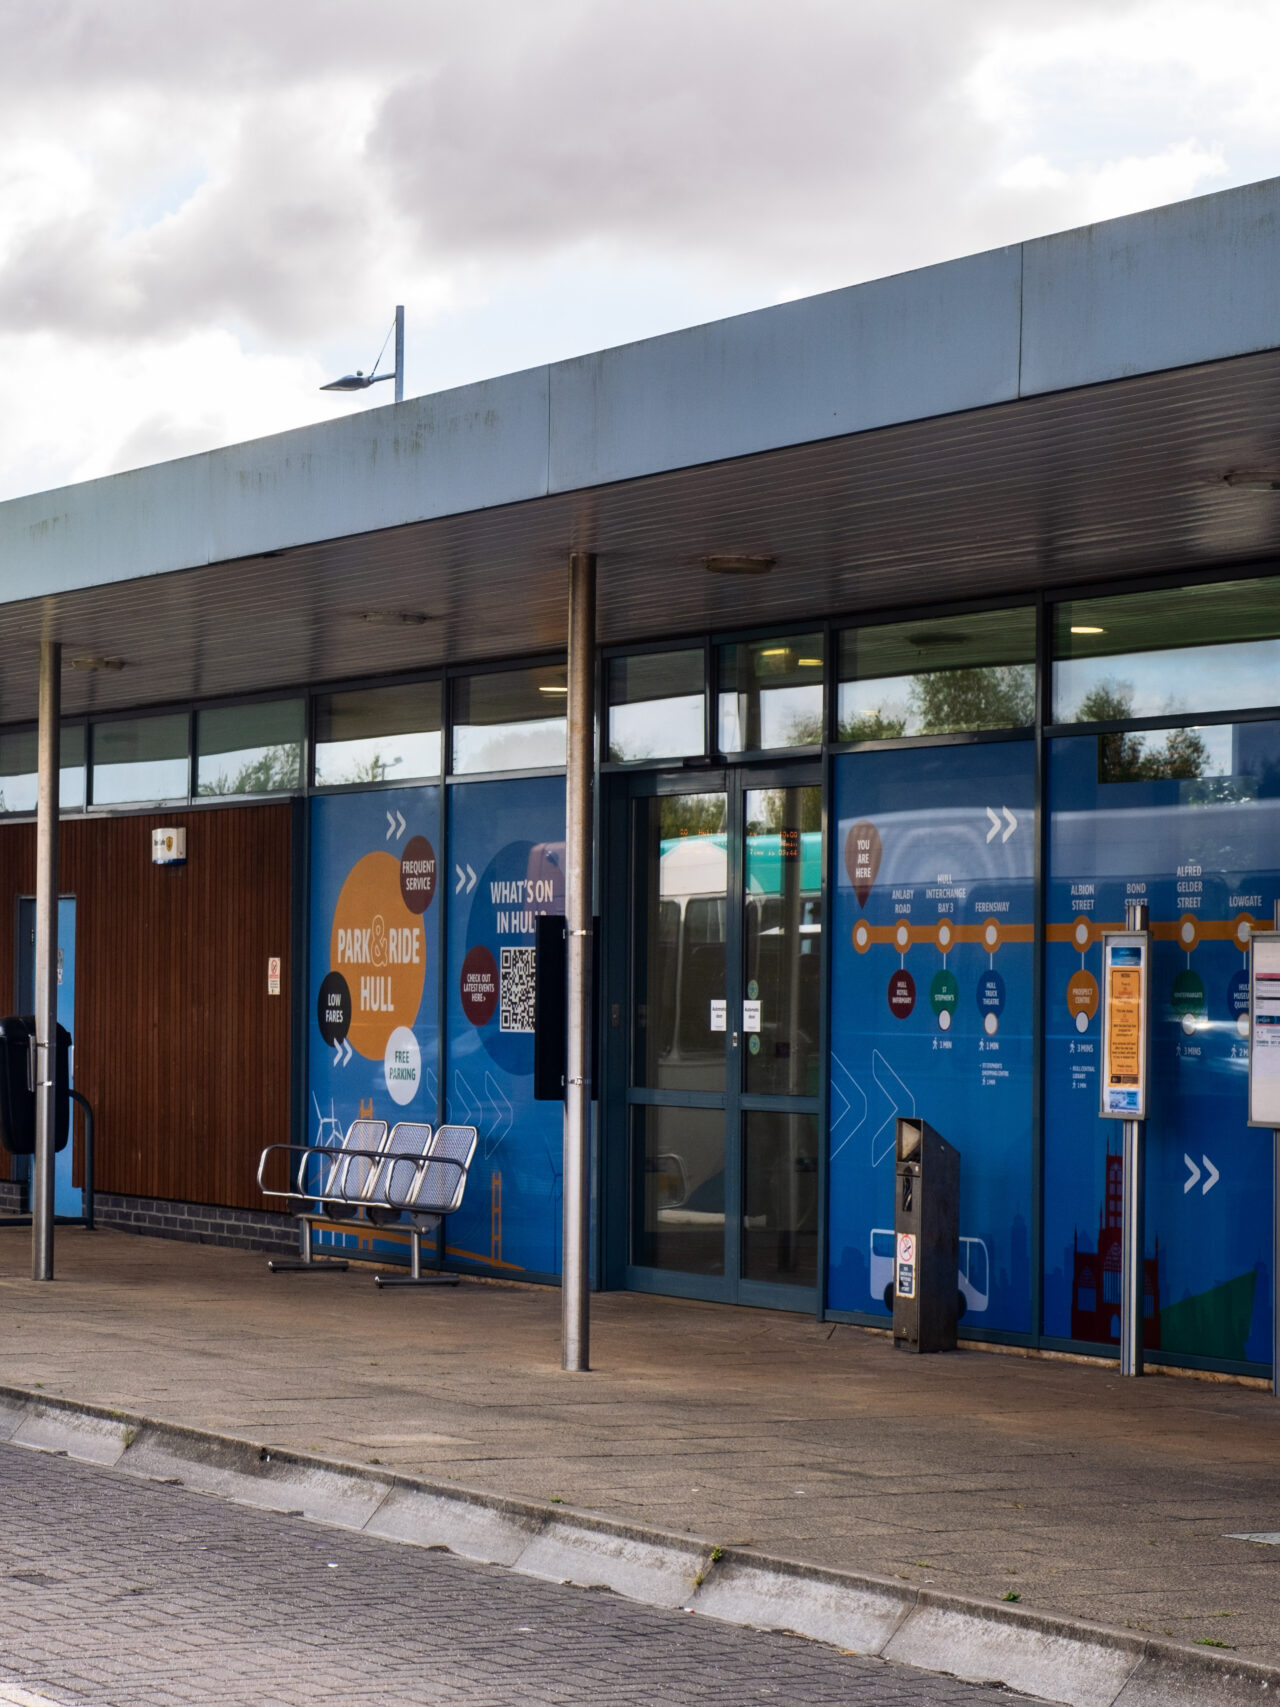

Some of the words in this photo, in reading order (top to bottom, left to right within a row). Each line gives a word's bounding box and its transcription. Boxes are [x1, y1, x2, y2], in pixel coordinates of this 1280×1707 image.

[857, 839, 870, 850] YOU
[857, 853, 870, 864] ARE
[402, 860, 435, 875] FREQUENT
[855, 868, 871, 878] HERE
[1177, 866, 1202, 877] ALFRED
[406, 877, 431, 891] SERVICE
[937, 874, 952, 885] HULL
[491, 880, 534, 904] WHAT'S
[536, 879, 553, 903] ON
[1071, 884, 1094, 895] ALBION
[1126, 883, 1146, 894] BOND
[1177, 881, 1202, 892] GELDER
[892, 889, 914, 900] ANLABY
[925, 888, 966, 899] INTERCHANGE
[975, 902, 1010, 912] FERENSWAY
[1072, 900, 1094, 910] STREET
[1177, 897, 1202, 908] STREET
[1229, 896, 1262, 907] LOWGATE
[895, 904, 911, 914] ROAD
[938, 903, 949, 913] BAY
[950, 903, 954, 913] 3
[497, 911, 508, 934] IN
[337, 928, 371, 963] PARK
[371, 914, 388, 967] &
[389, 928, 420, 963] RIDE
[467, 974, 480, 982] CHECK
[481, 974, 491, 982] OUT
[360, 976, 394, 1011] HULL
[463, 983, 478, 993] LATEST
[478, 983, 495, 993] EVENTS
[328, 993, 341, 1006] LOW
[472, 993, 483, 1002] HERE
[1234, 1001, 1249, 1009] QUART
[325, 1010, 343, 1023] FARES
[395, 1050, 410, 1064] FREE
[389, 1067, 416, 1081] PARKING
